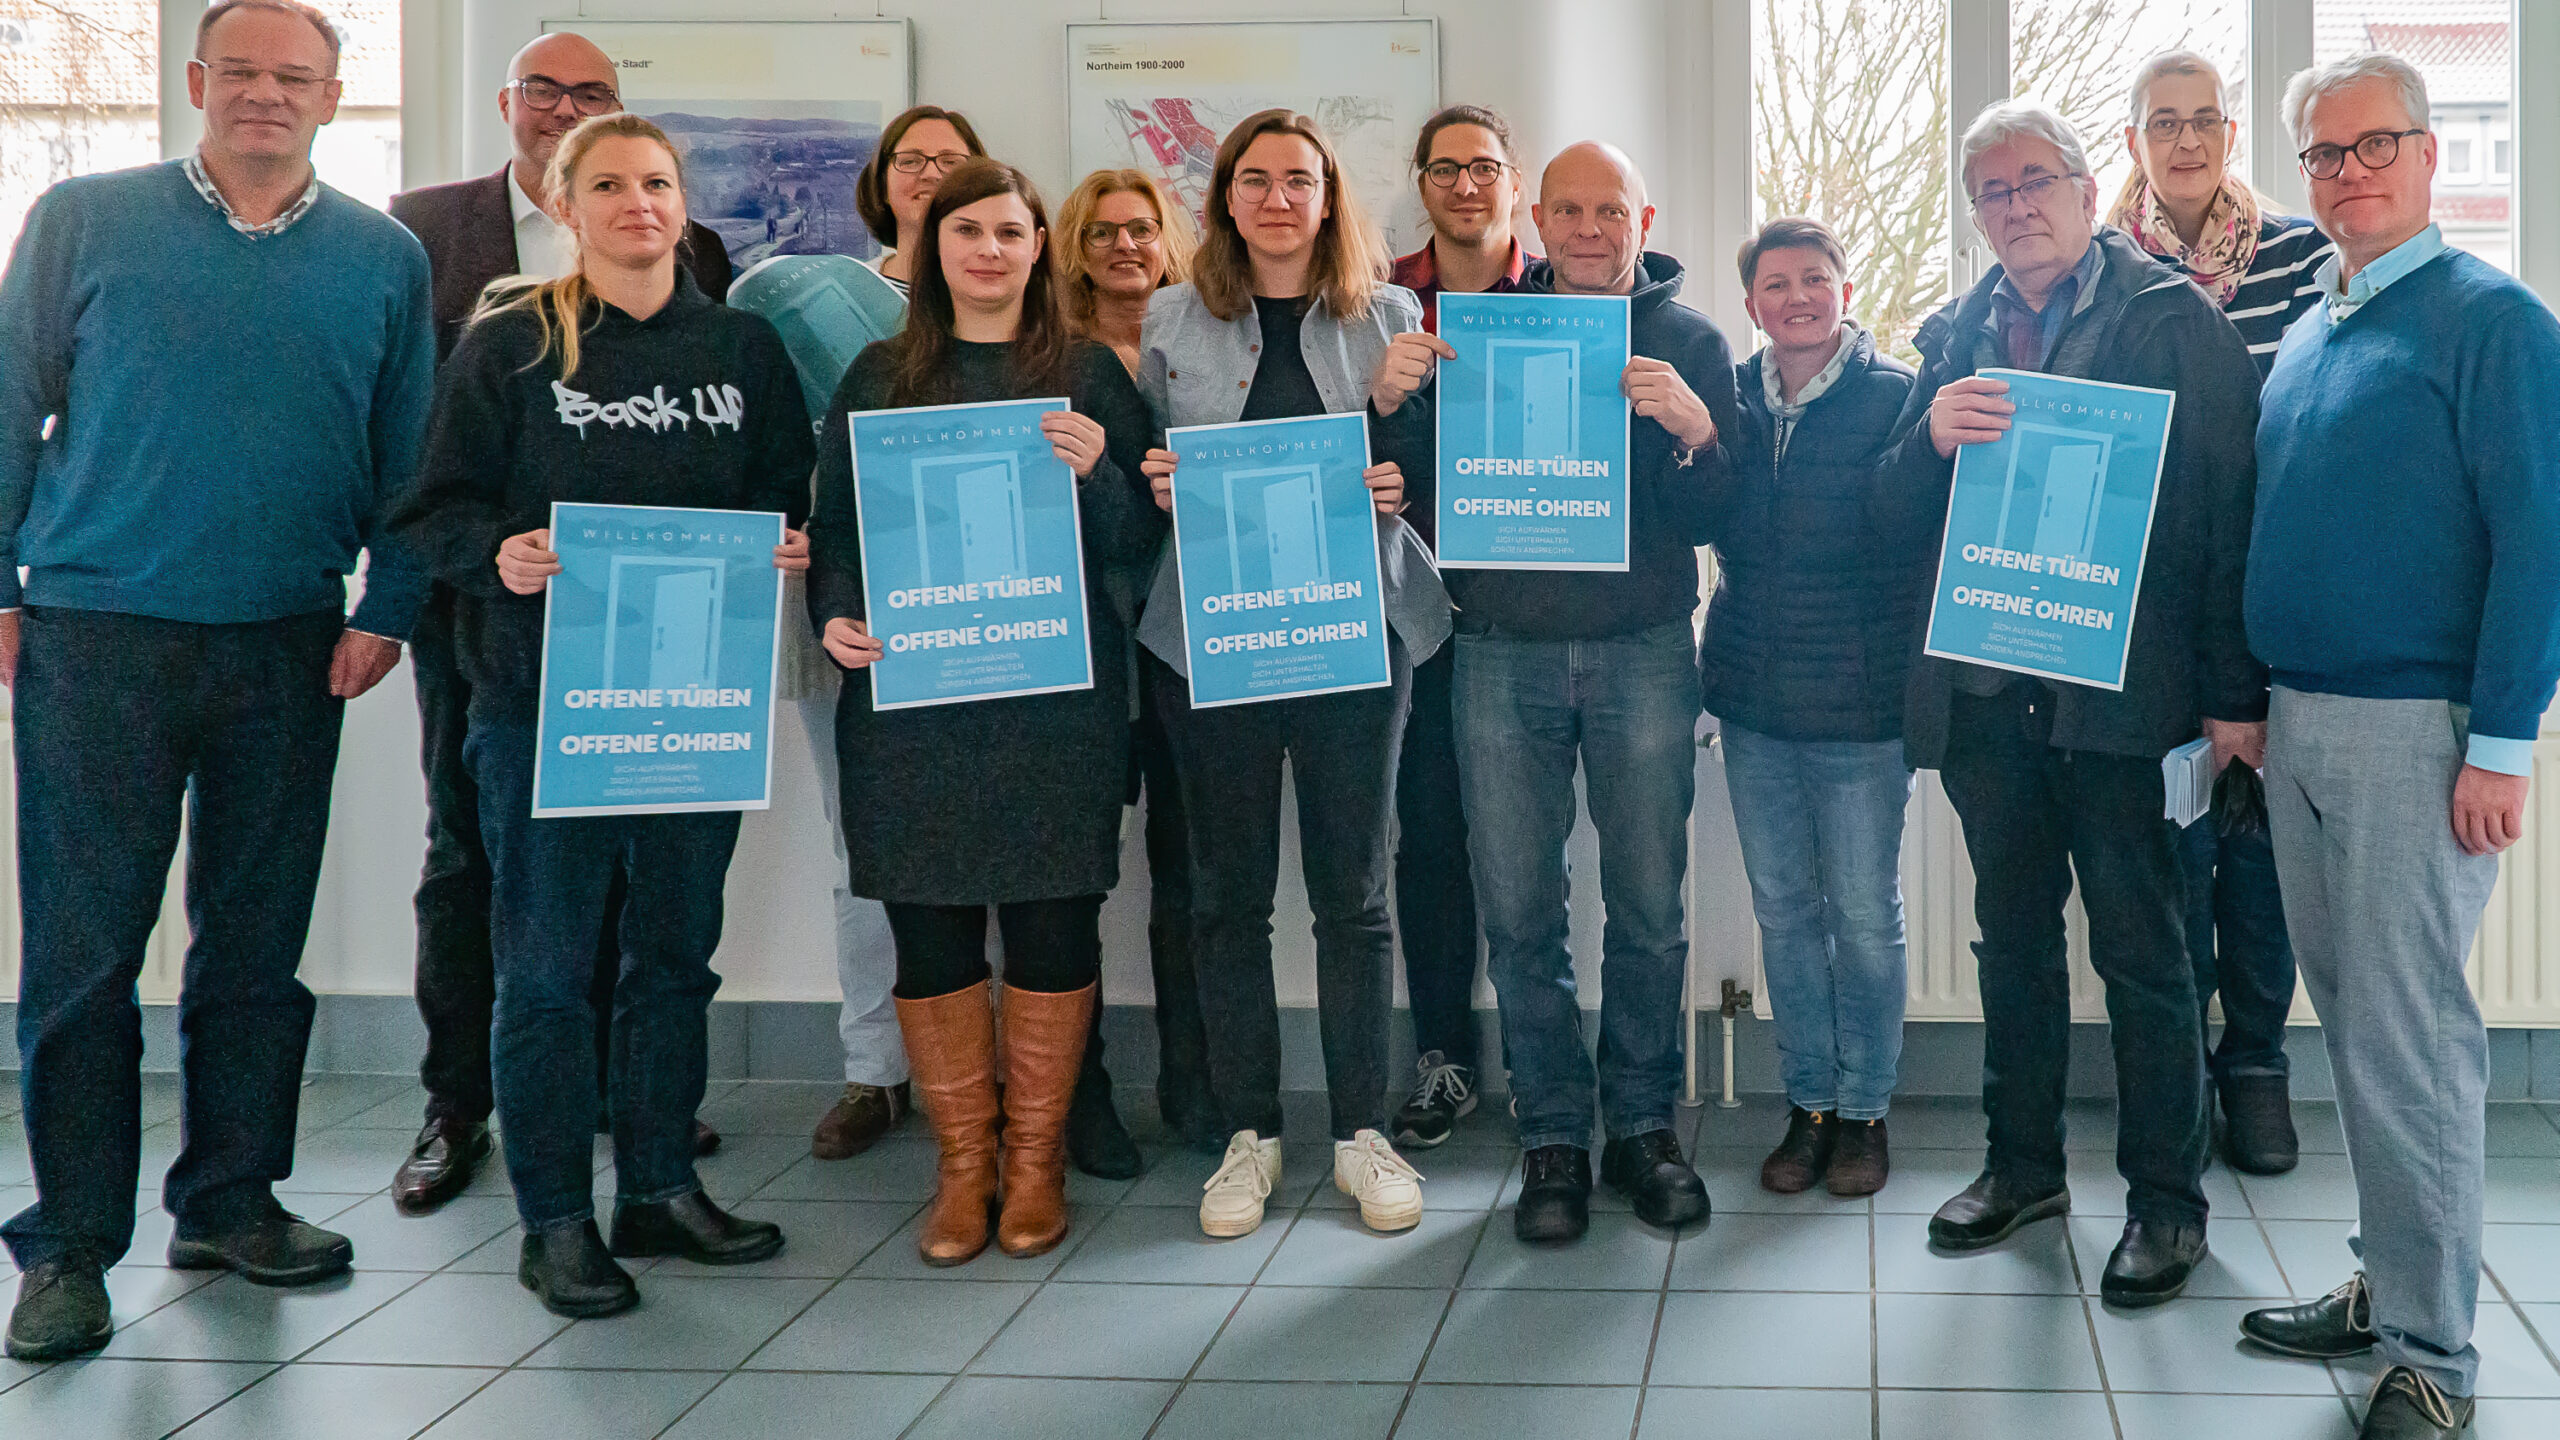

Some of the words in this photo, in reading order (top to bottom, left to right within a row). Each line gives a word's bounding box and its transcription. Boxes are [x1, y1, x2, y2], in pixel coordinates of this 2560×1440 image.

[1086, 60, 1132, 71] Northeim
[1135, 60, 1185, 70] 1900-2000
[1463, 315, 1604, 328] WILLKOMMEN!
[551, 380, 690, 440] Back
[1195, 438, 1343, 460] WILLKOMMEN!
[1455, 457, 1535, 476] OFFENE
[1537, 455, 1609, 477] TÜREN
[1453, 497, 1533, 516] OFFENE
[1536, 499, 1611, 517] OHREN
[582, 528, 754, 545] WILLKOMMEN!
[1961, 543, 2044, 574] OFFENE
[2046, 554, 2121, 587] TÜREN
[888, 583, 980, 609] OFFENE
[982, 575, 1062, 599] TÜREN
[1202, 589, 1286, 614] OFFENE
[1288, 580, 1362, 605] TÜREN
[1952, 585, 2033, 617] OFFENE
[2035, 599, 2115, 631] OHREN
[889, 626, 981, 653] OFFENE
[984, 617, 1068, 643] OHREN
[1204, 630, 1288, 655] OFFENE
[1291, 620, 1368, 645] OHREN
[564, 689, 662, 709] OFFENE
[666, 683, 751, 708] TÜREN
[559, 733, 659, 755] OFFENE
[661, 732, 751, 753] OHREN
